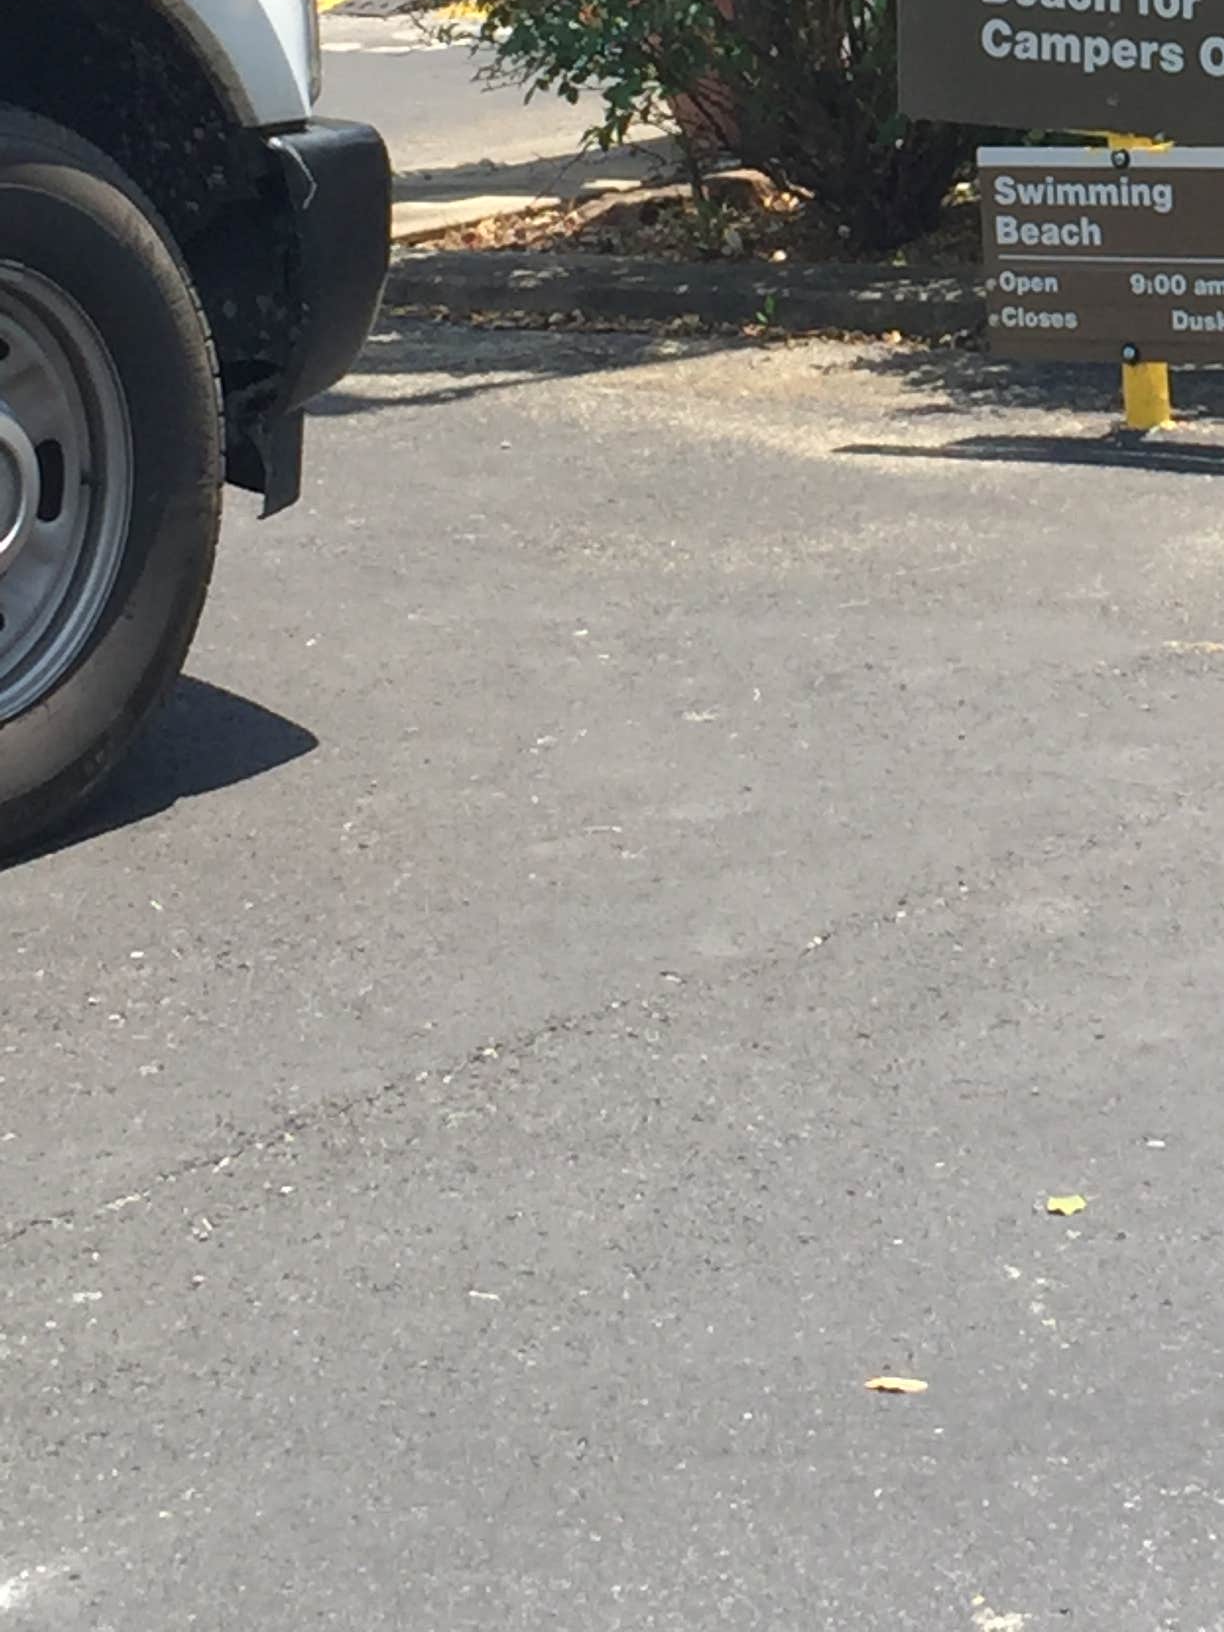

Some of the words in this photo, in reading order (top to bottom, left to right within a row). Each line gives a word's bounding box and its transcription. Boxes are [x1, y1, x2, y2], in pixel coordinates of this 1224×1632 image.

[981, 19, 1185, 72] Campers
[993, 175, 1174, 211] Swimming
[995, 215, 1102, 246] Beach
[999, 271, 1058, 295] Open
[1129, 273, 1186, 296] 9:00
[1001, 306, 1078, 330] Closes
